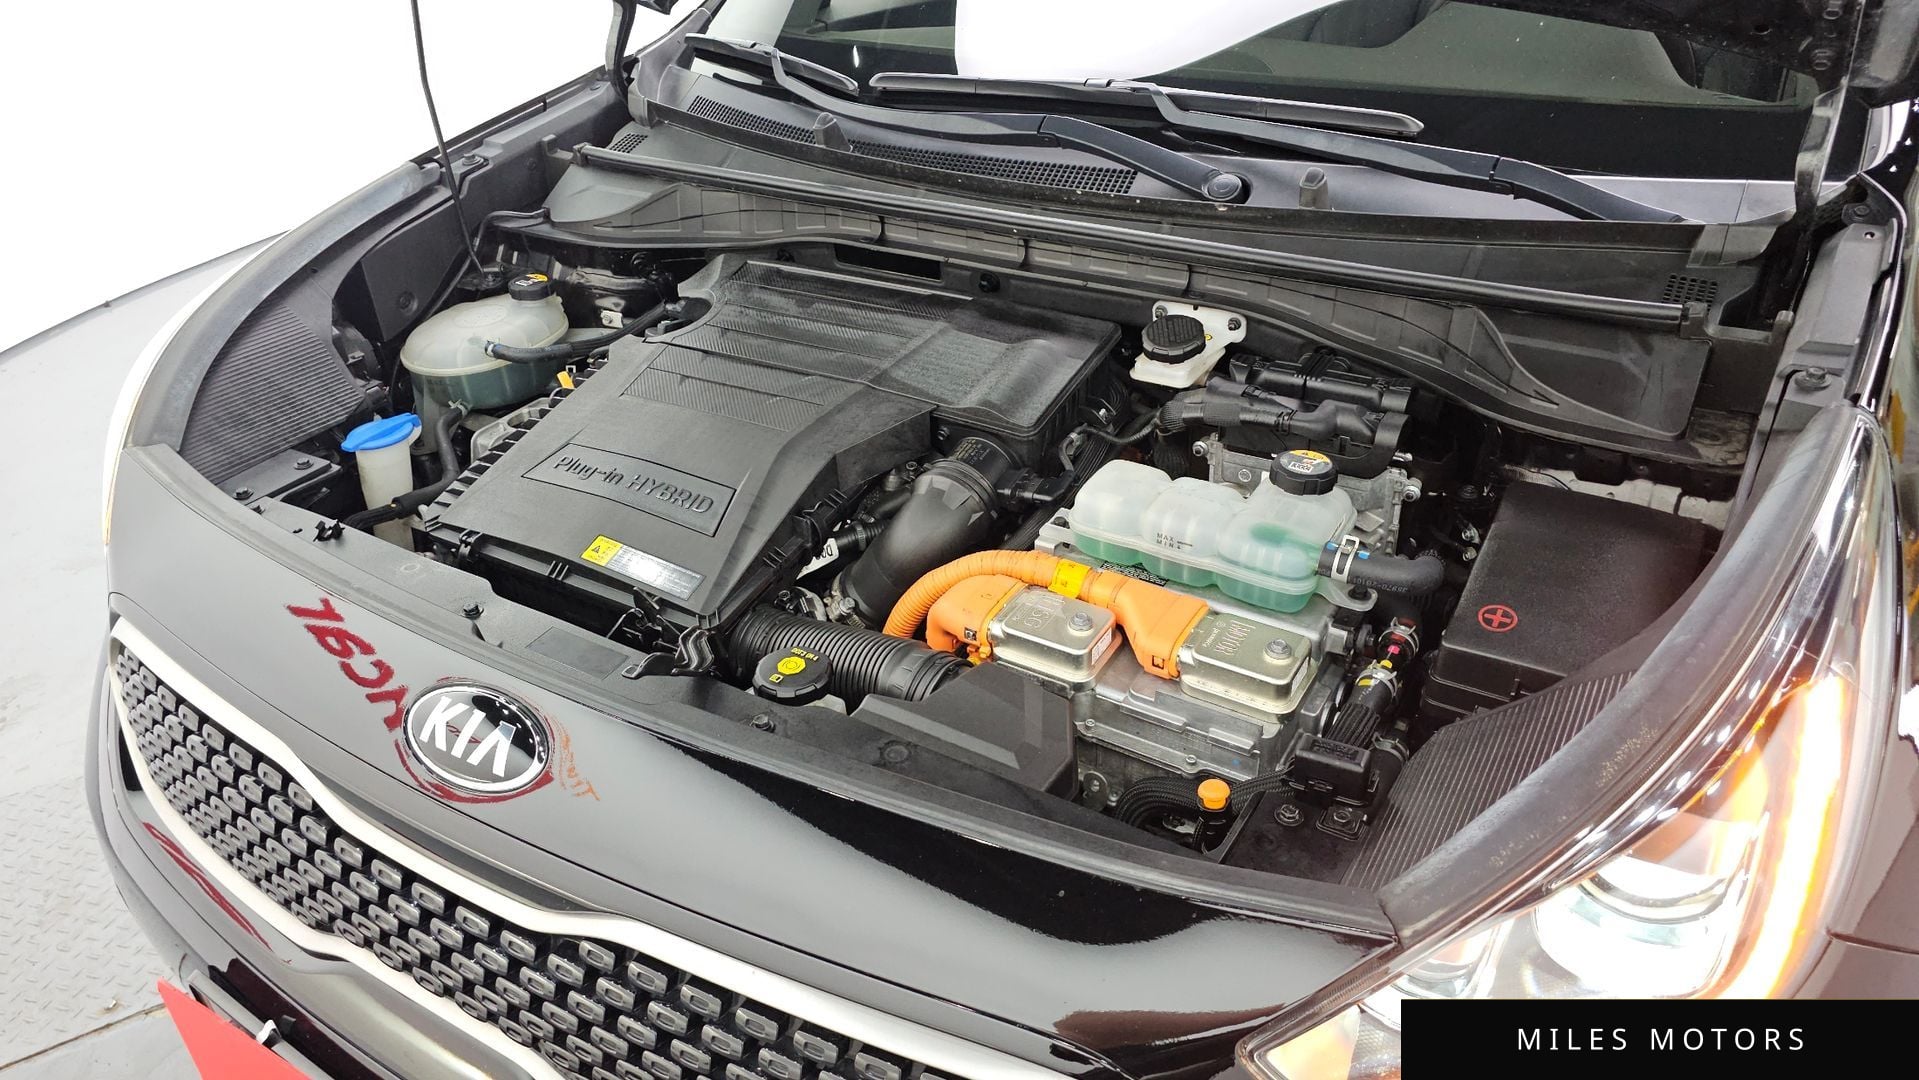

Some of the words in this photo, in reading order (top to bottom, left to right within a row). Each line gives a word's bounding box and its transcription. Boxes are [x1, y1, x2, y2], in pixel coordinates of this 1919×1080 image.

[552, 455, 624, 488] Plug-in
[626, 472, 715, 514] HYBRID
[1156, 532, 1174, 542] MAX
[419, 695, 518, 777] KIA
